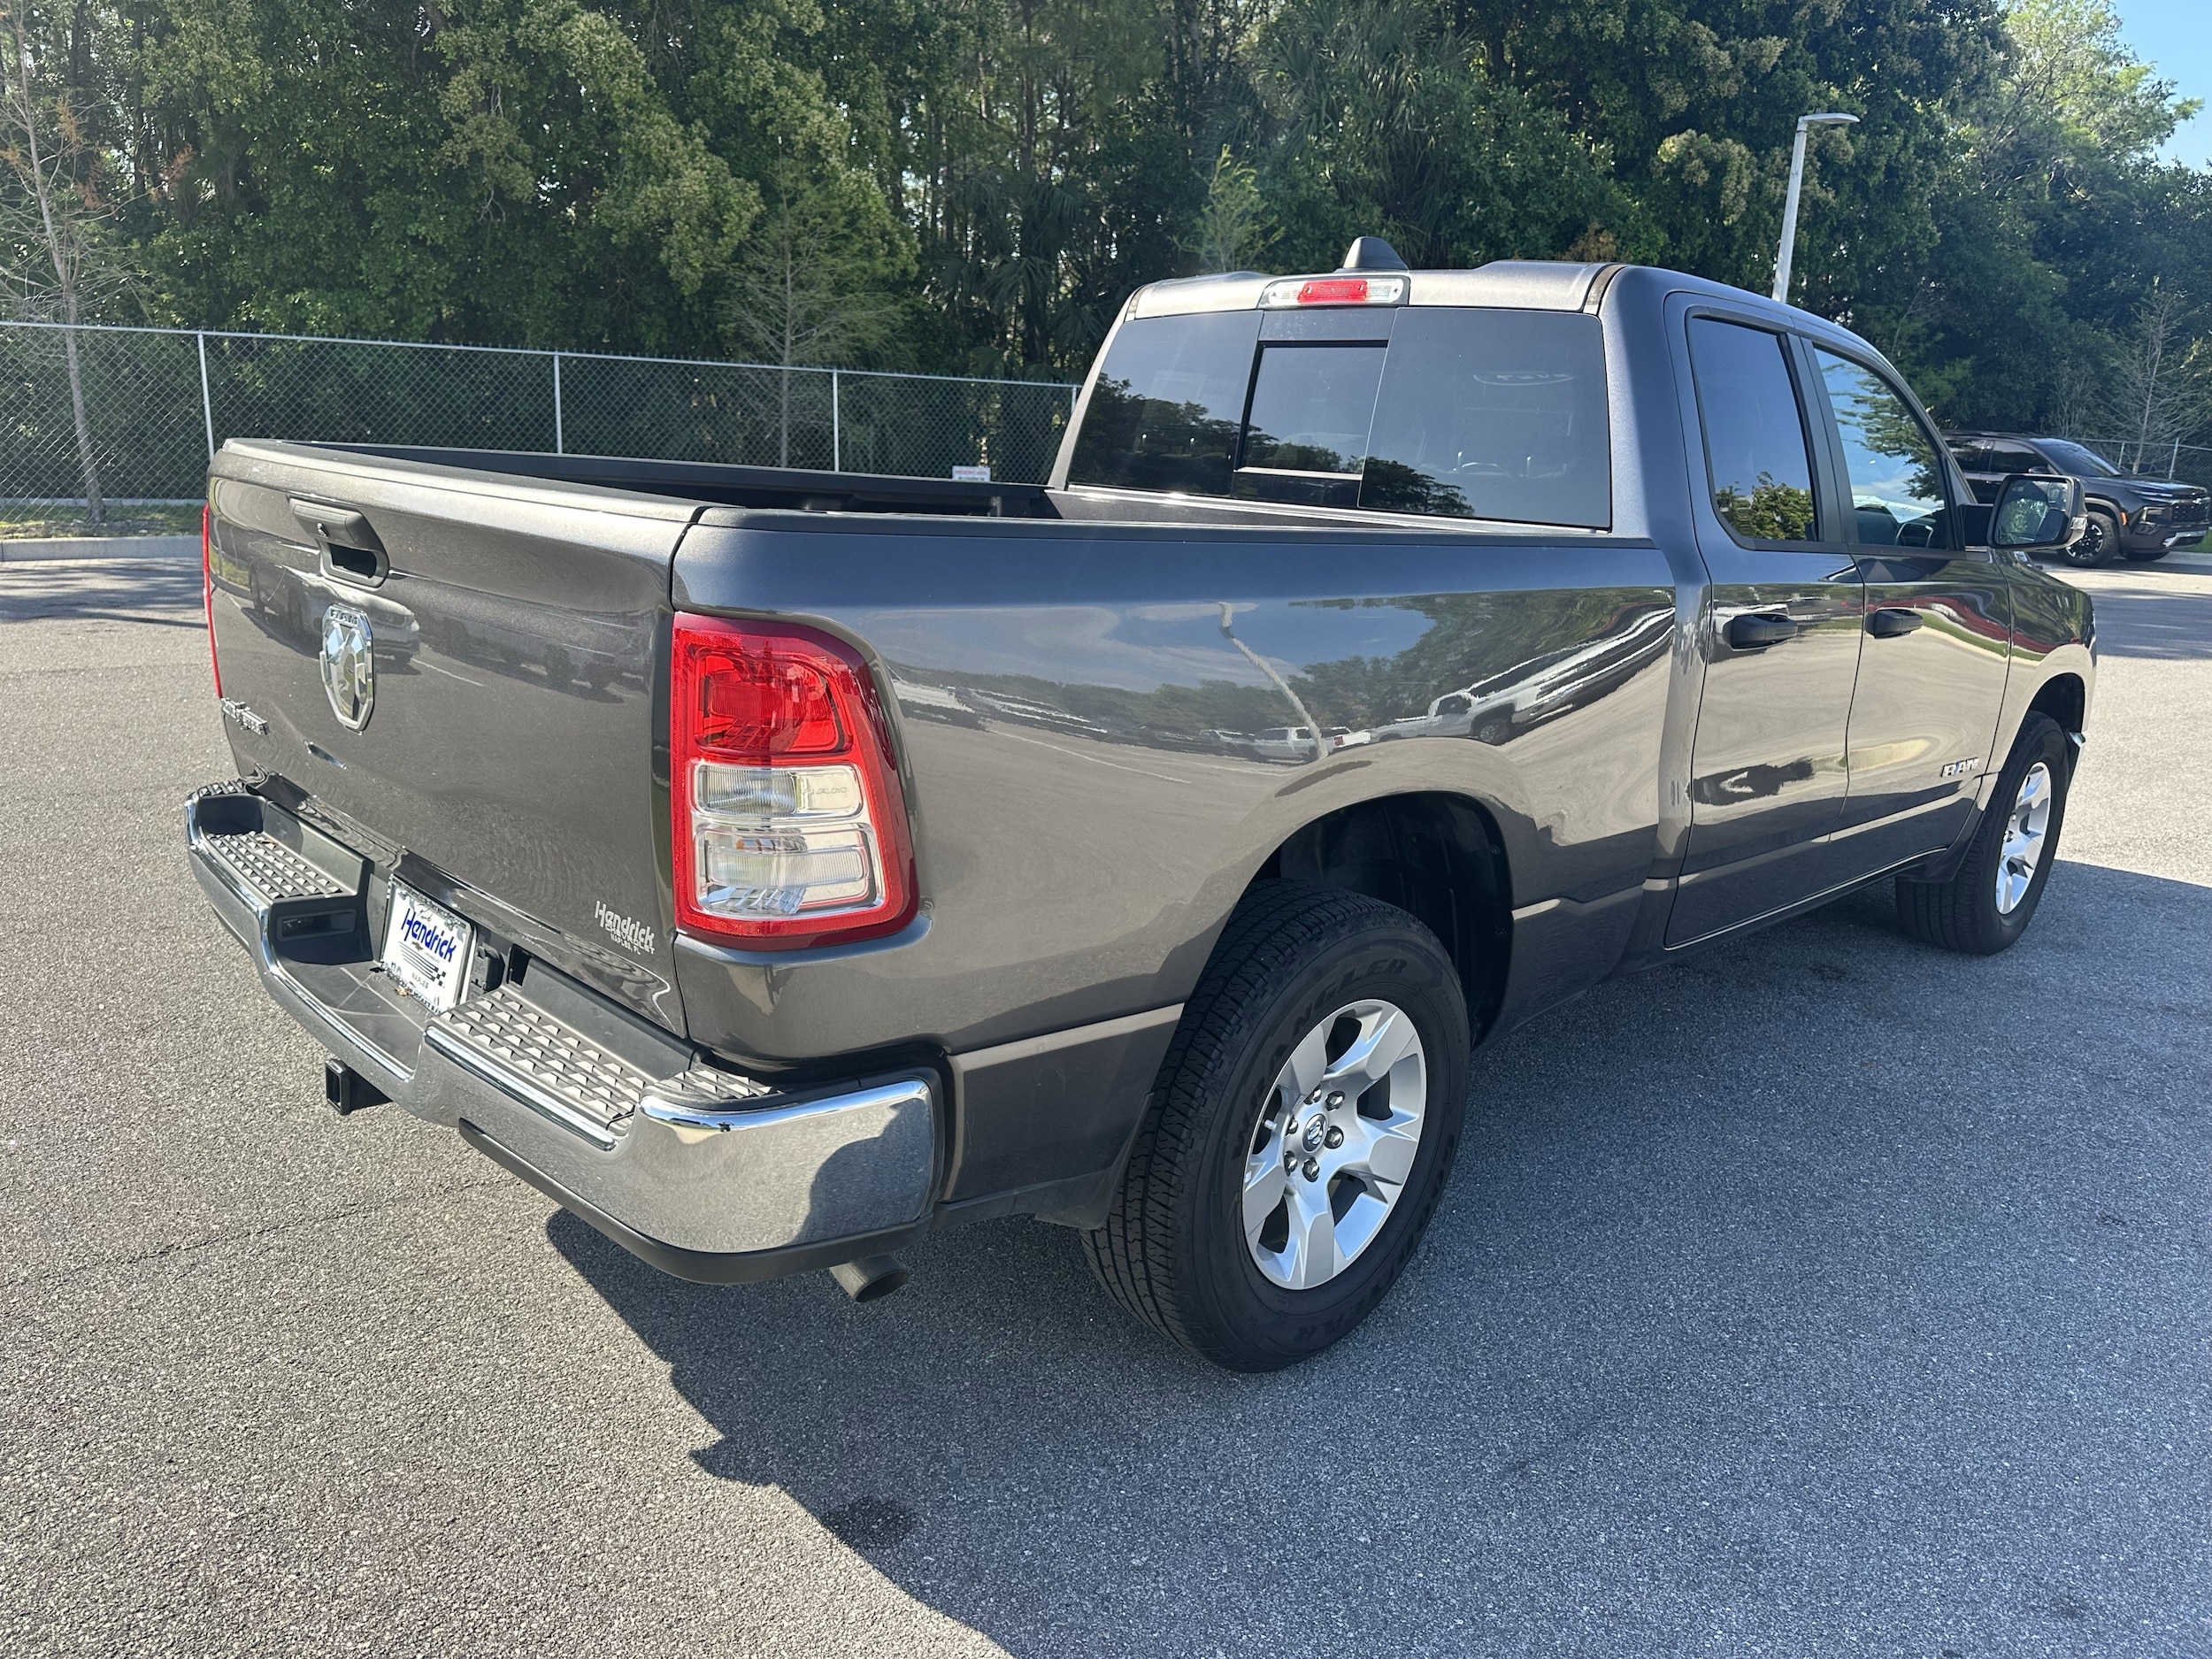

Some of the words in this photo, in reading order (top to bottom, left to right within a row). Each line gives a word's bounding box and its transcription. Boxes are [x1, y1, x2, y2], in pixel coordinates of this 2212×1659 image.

[1939, 757, 1980, 778] RAM
[400, 908, 457, 963] Hendrick
[594, 900, 656, 948] Hendrick
[604, 923, 656, 955] CHEVROLET
[1231, 957, 1409, 1159] WRANGLER
